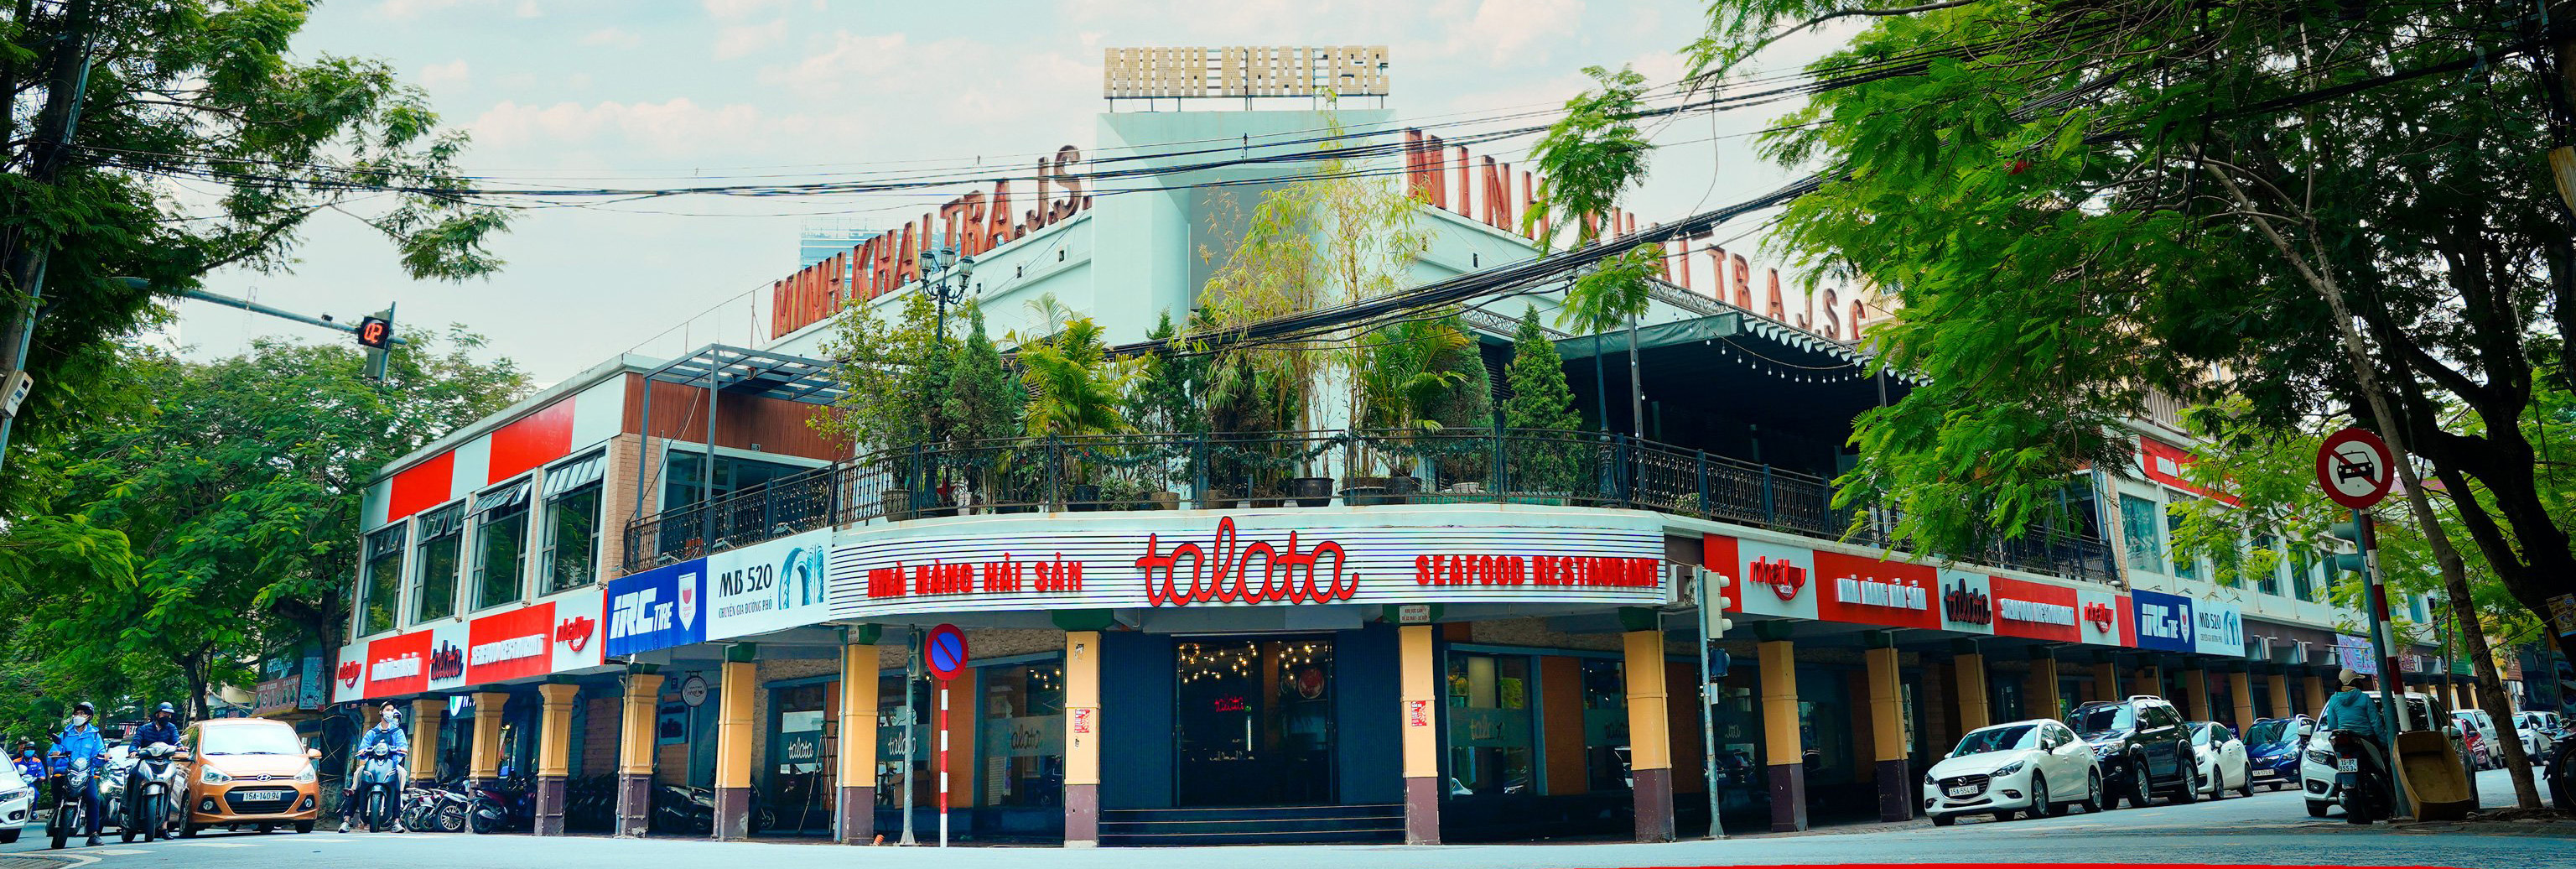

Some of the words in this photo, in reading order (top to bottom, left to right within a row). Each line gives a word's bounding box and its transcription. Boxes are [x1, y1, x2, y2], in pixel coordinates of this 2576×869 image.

[1104, 47, 1207, 98] MINH
[1221, 46, 1311, 97] KHAI
[1405, 127, 1550, 242] MINH
[771, 251, 847, 341] MINH
[850, 211, 934, 302] KHAI
[868, 560, 906, 598] NHÀ
[915, 558, 974, 595] HÀNG
[984, 552, 1021, 592] HẢI
[1034, 552, 1083, 592] SẢN
[1135, 516, 1360, 607] talata
[1415, 554, 1525, 586] SEAFOOD
[1532, 556, 1660, 587] RESTAURANT
[719, 570, 744, 598] MB
[747, 563, 773, 593] 520
[653, 601, 673, 632] TIRE
[2199, 611, 2210, 629] MB
[2210, 613, 2221, 630] 520
[788, 736, 813, 759] talata
[888, 731, 917, 755] talaa
